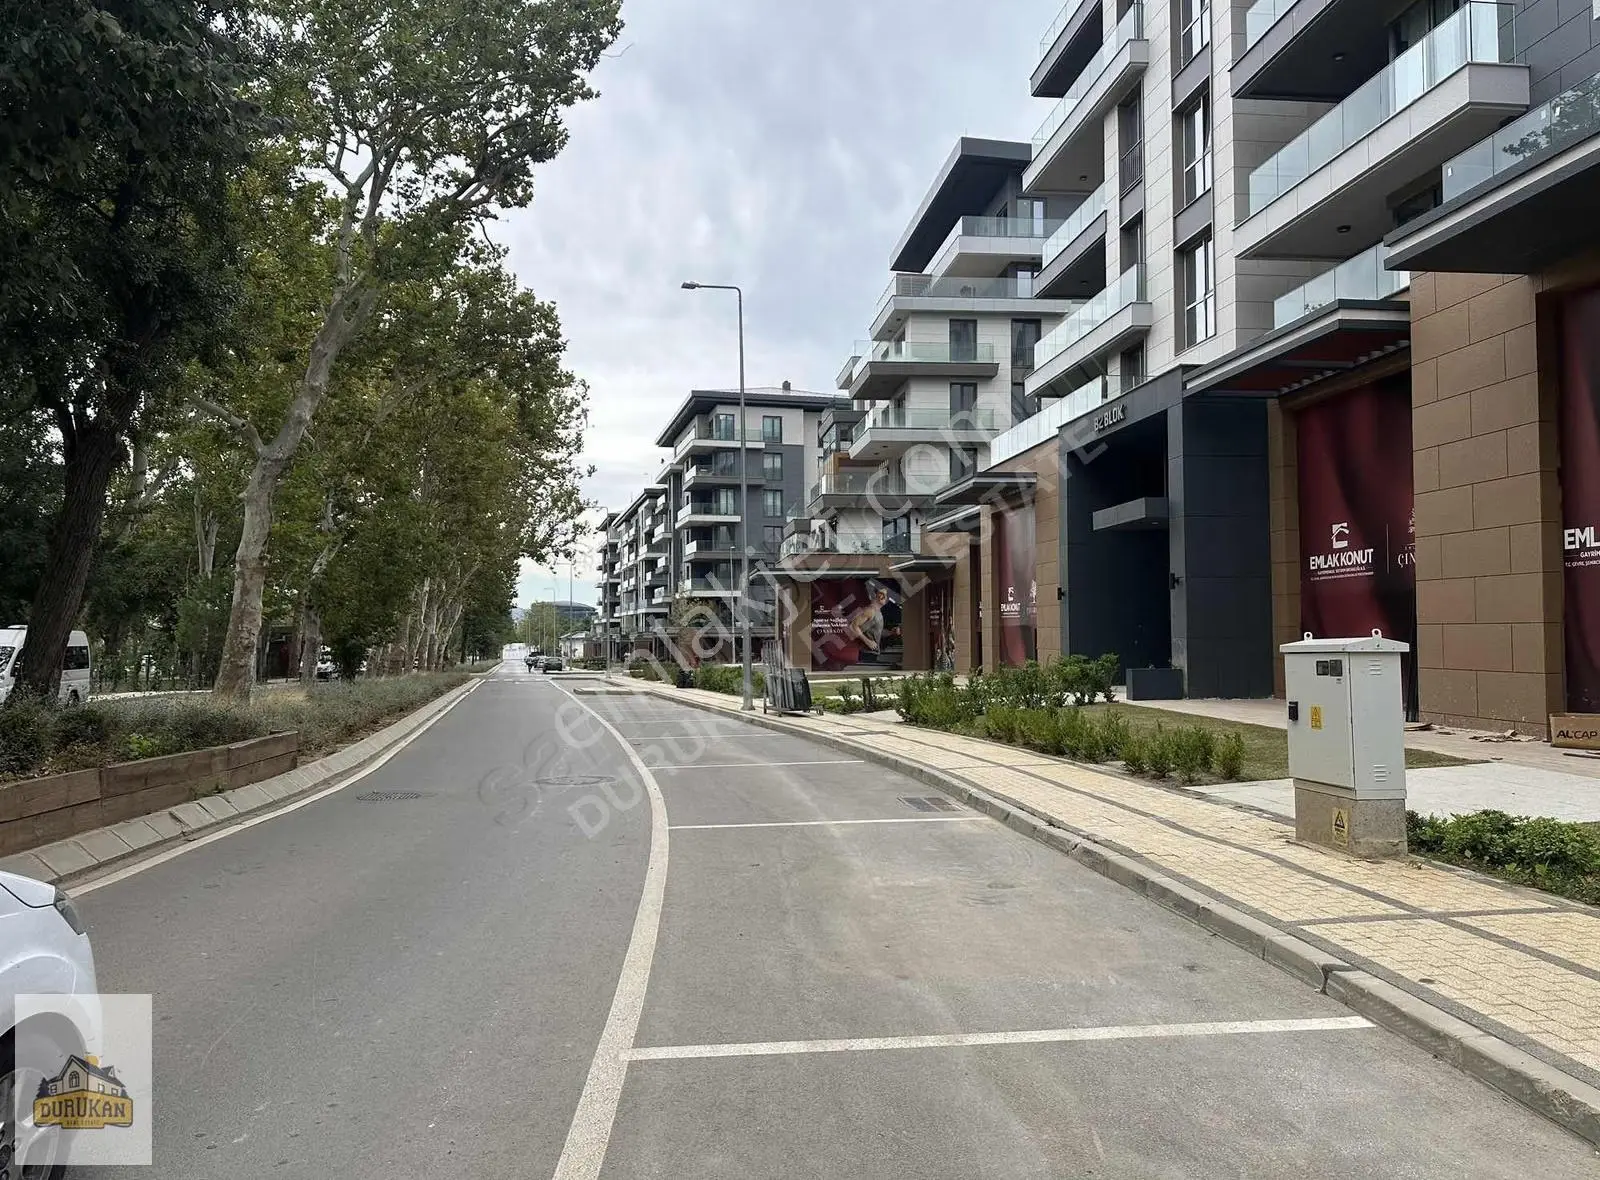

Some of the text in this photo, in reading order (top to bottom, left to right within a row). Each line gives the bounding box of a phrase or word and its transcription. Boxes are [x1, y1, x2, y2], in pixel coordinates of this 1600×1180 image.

[1093, 404, 1126, 432] B2 BLOK
[1310, 552, 1340, 570] EMLAK
[1340, 548, 1374, 567] KONUT
